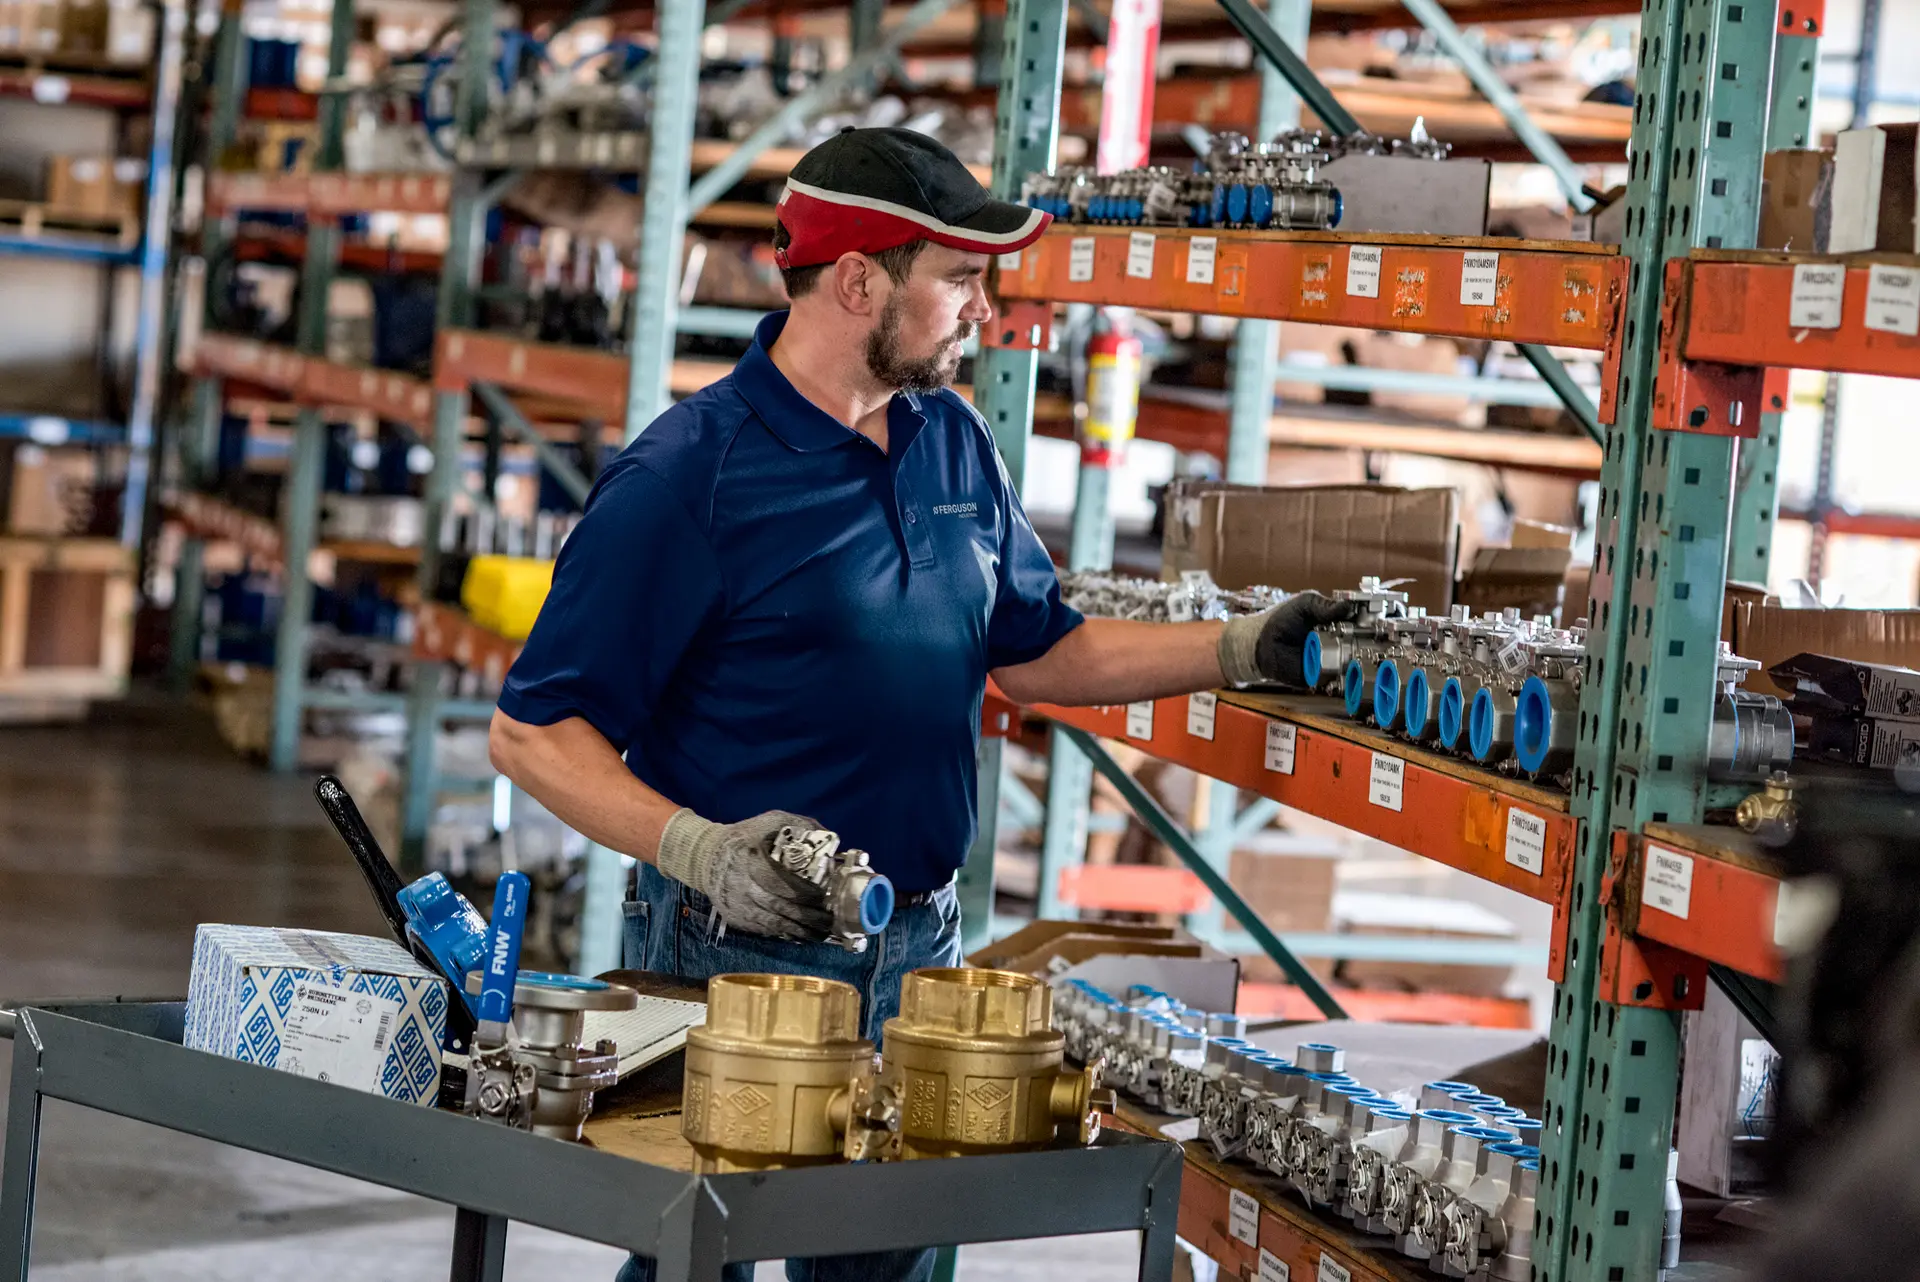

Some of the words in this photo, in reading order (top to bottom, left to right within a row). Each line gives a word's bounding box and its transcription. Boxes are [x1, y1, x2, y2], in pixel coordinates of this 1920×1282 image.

[939, 502, 977, 514] FERGUSON
[1857, 723, 1869, 763] RIDGID
[491, 931, 511, 976] FNW
